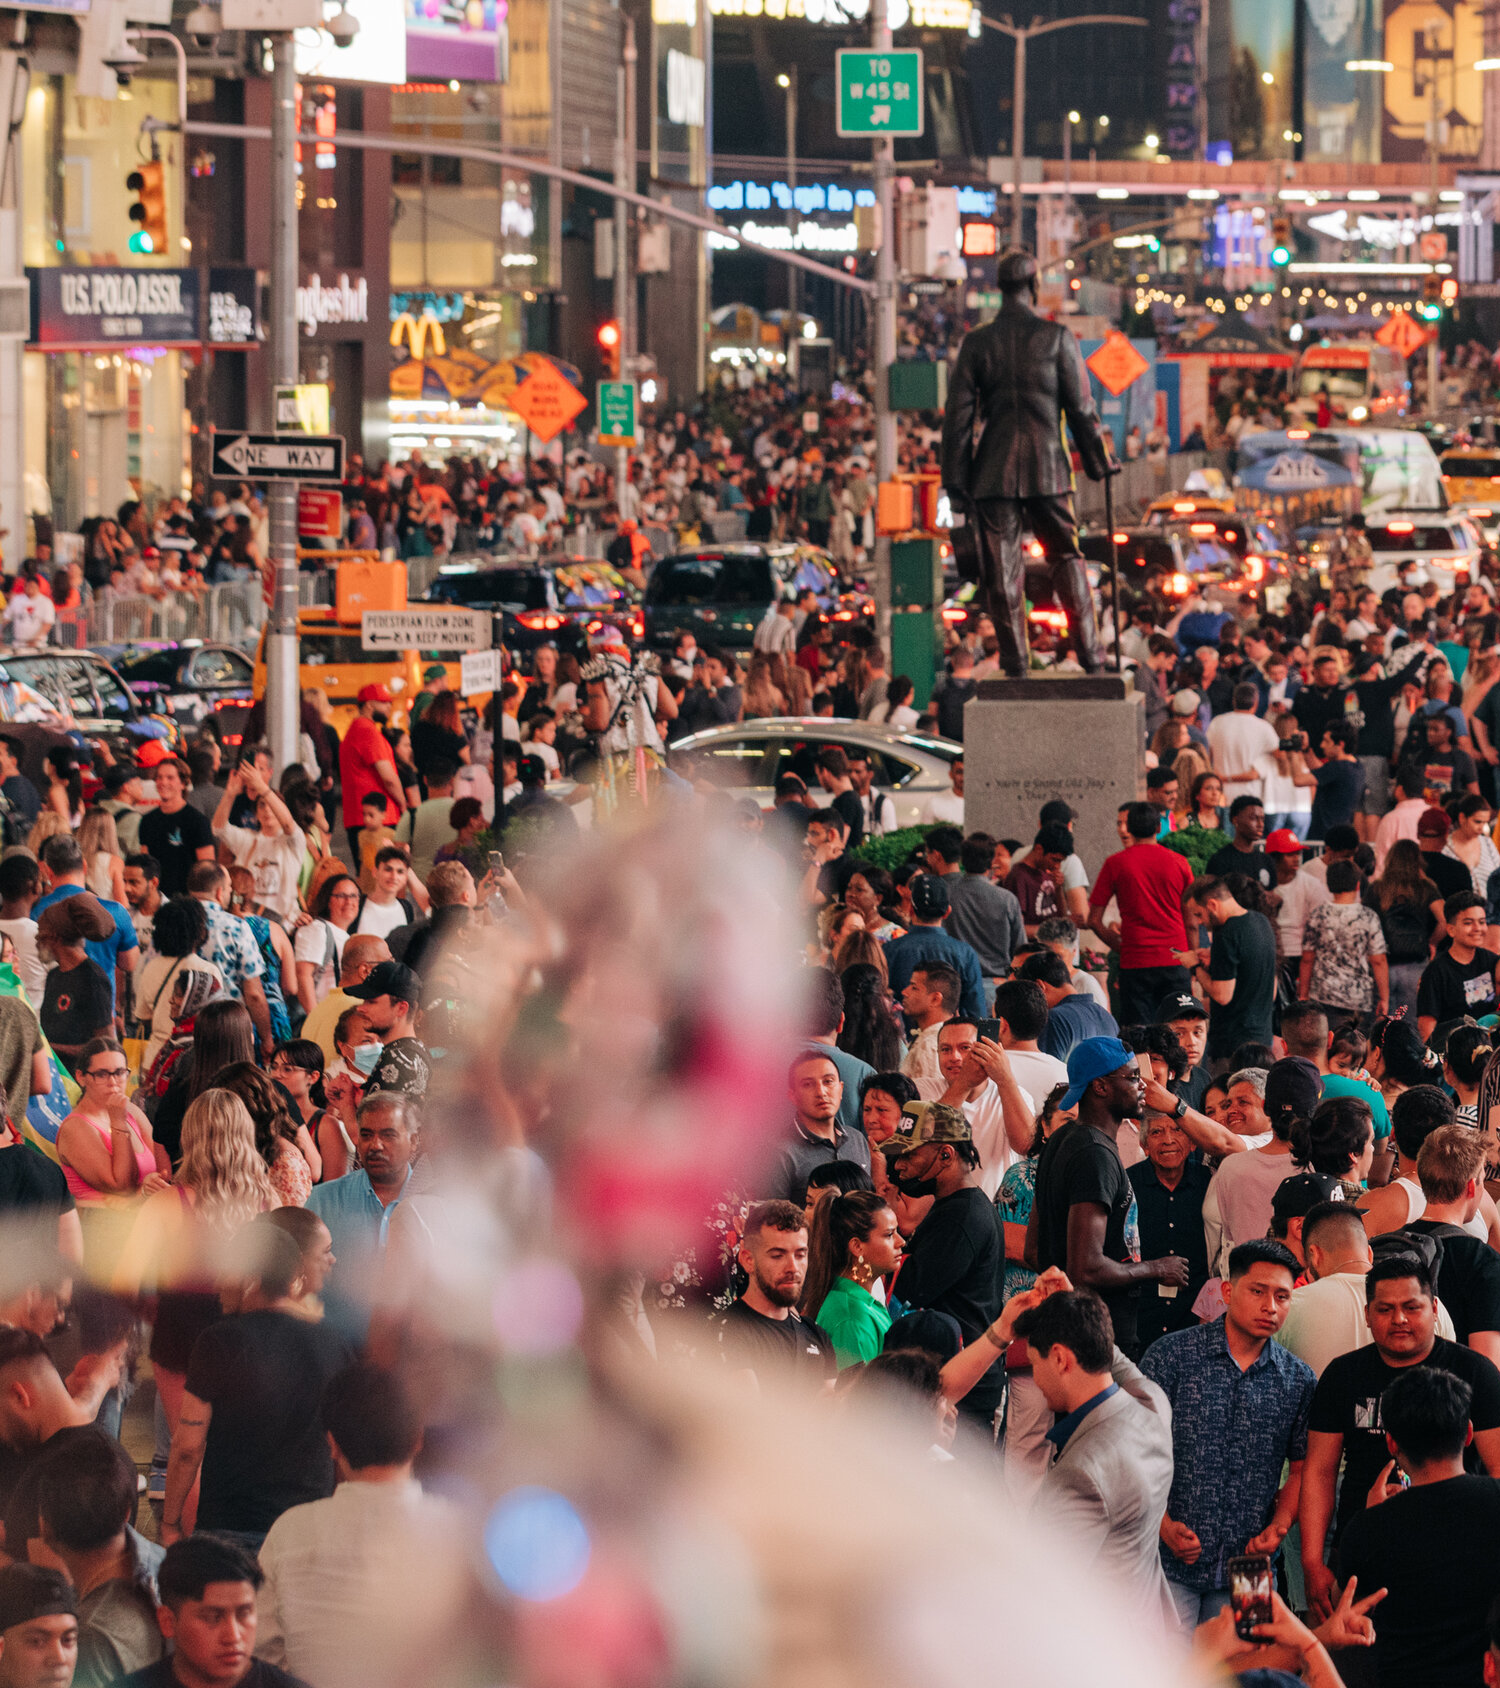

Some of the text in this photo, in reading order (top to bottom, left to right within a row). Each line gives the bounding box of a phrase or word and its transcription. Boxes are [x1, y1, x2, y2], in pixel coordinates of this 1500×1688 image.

[869, 59, 891, 77] TO
[850, 83, 865, 99] W
[866, 83, 891, 99] 45
[91, 274, 137, 315] POLO
[233, 446, 326, 465] ONE WAY
[367, 615, 475, 628] PEDESTRIAN FLOW ZONE
[416, 632, 476, 644] KEEP MOVING
